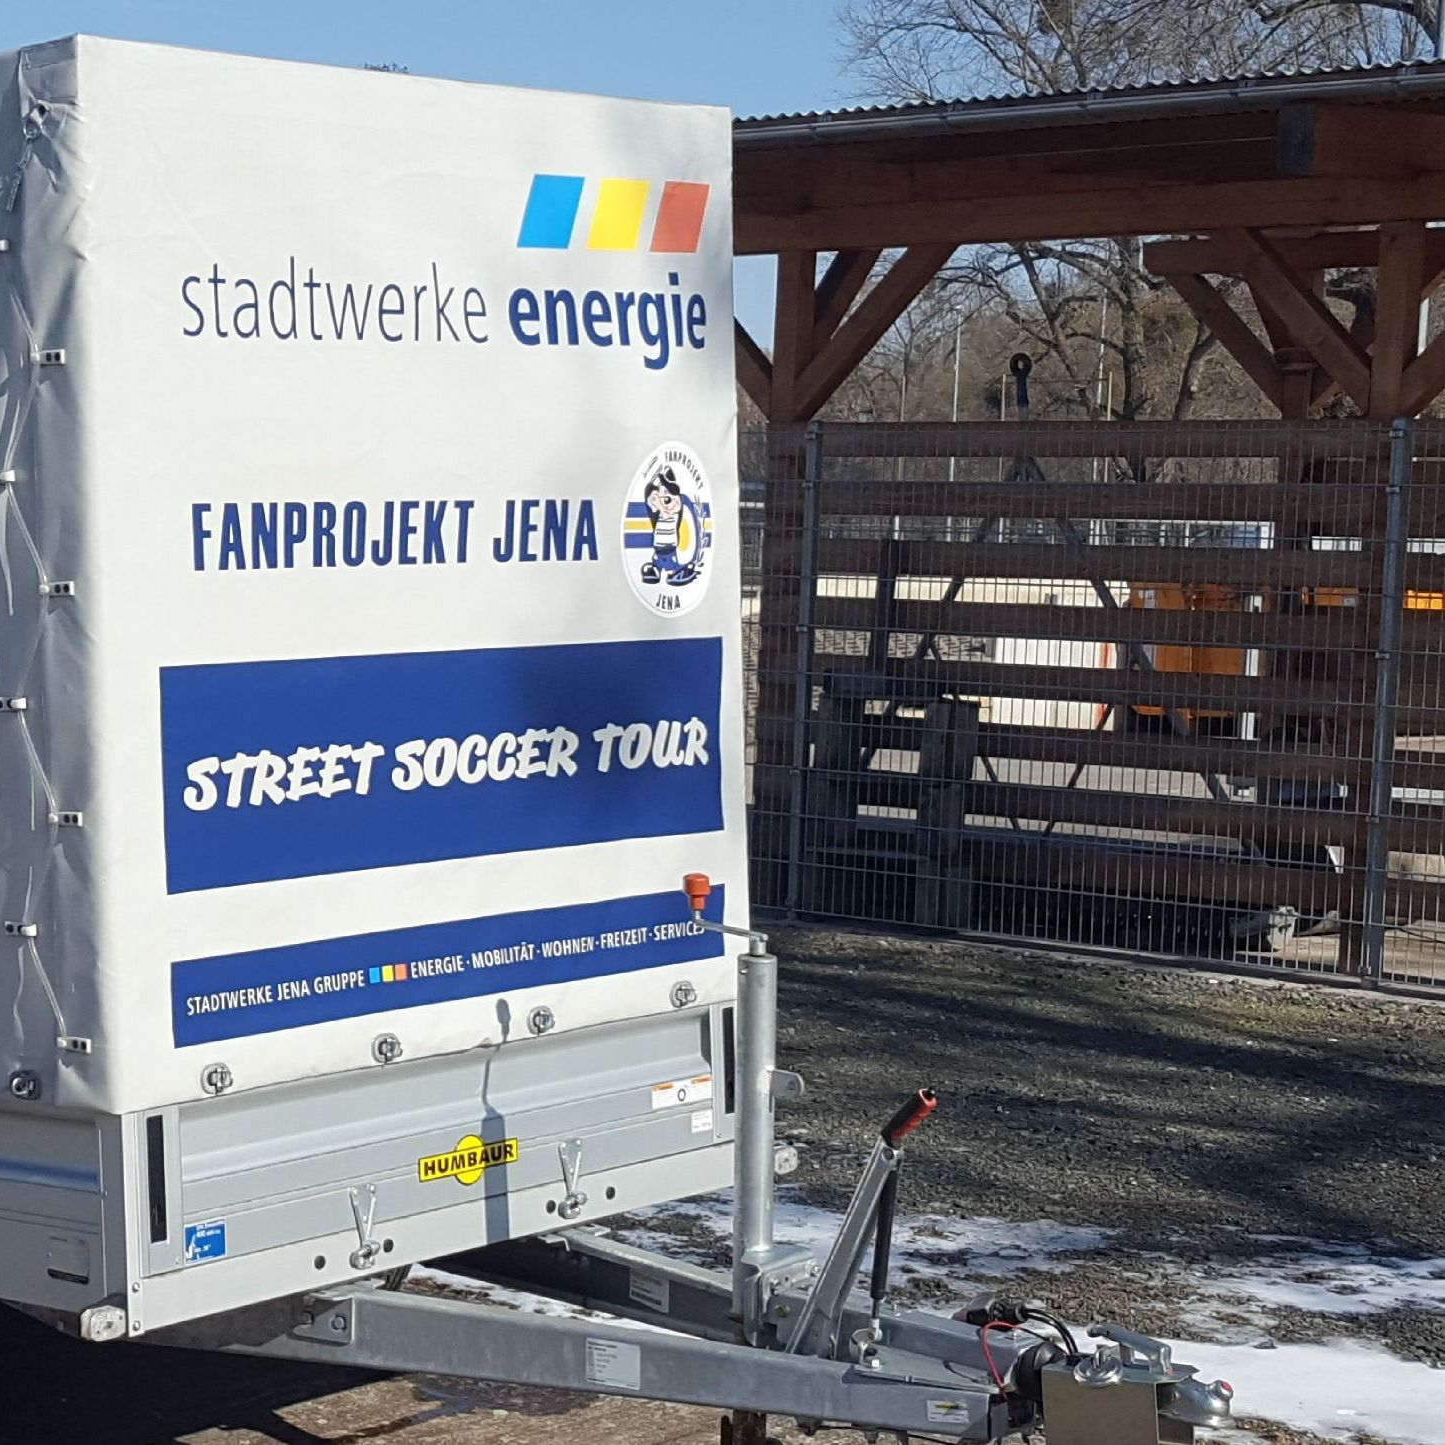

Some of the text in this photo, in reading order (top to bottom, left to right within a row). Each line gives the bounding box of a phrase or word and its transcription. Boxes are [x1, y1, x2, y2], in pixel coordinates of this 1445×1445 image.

[181, 256, 708, 371] stadtwerke energie
[664, 450, 704, 490] FANPROJEKT
[191, 499, 599, 571] FANPROJEKT JENA
[655, 593, 681, 611] JENA
[183, 716, 710, 812] STREET SOCCER TOUR
[186, 985, 274, 1016] STADTWERKE
[277, 978, 311, 1001] JENA
[314, 969, 365, 995] GRUPPE
[410, 955, 465, 979] ENERGIE
[471, 942, 535, 969] MOBILITÄT
[541, 936, 596, 958] WOHNEN
[600, 926, 649, 950] FREIZEIT
[423, 1143, 515, 1177] HUMBAUR
